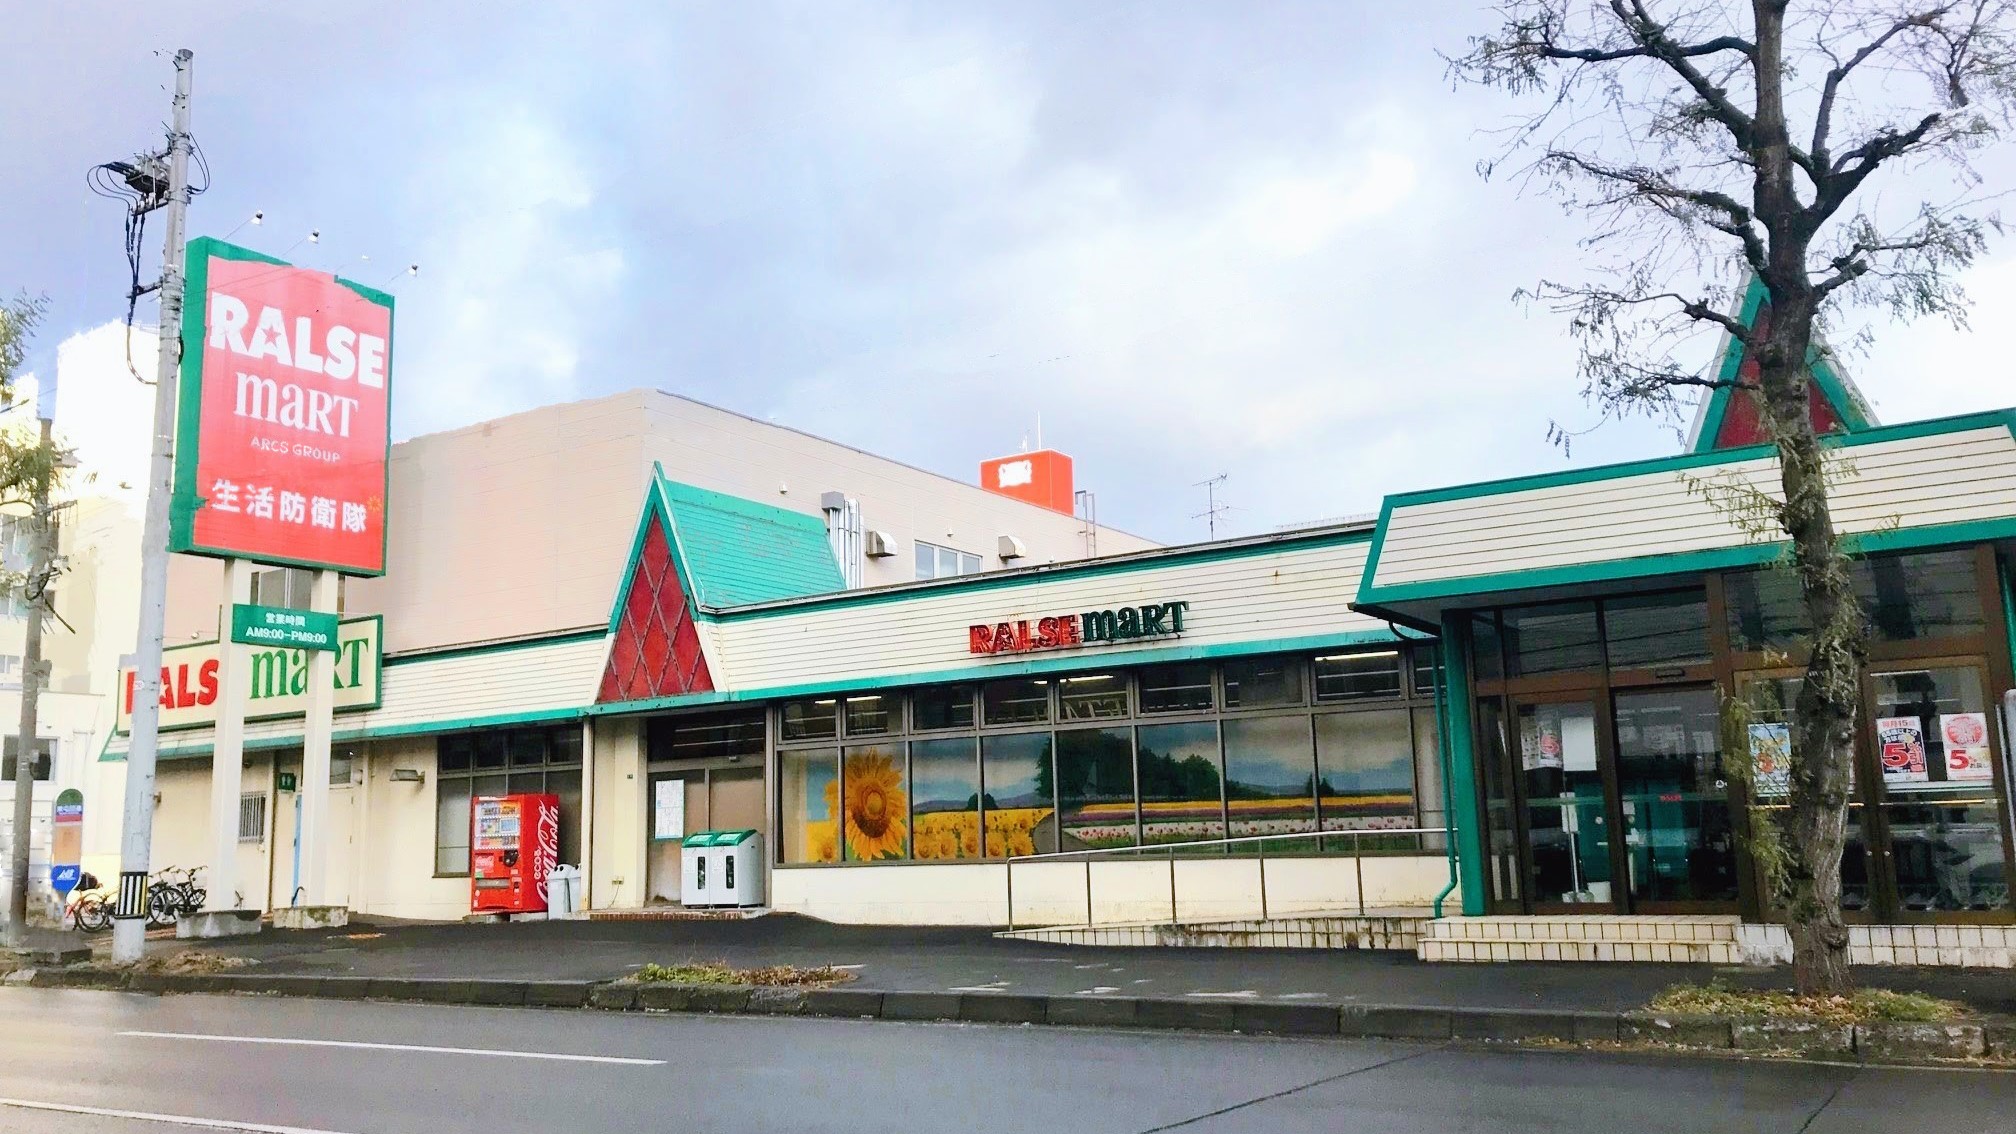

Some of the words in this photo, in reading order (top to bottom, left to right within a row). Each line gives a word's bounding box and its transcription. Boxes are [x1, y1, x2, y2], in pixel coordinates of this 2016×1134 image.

[209, 291, 385, 389] RALSE
[251, 436, 289, 454] ARCS
[292, 443, 341, 463] GROUP
[211, 478, 368, 533] 生活防衛隊
[969, 614, 1082, 654] RALSE
[125, 658, 220, 715] ALS
